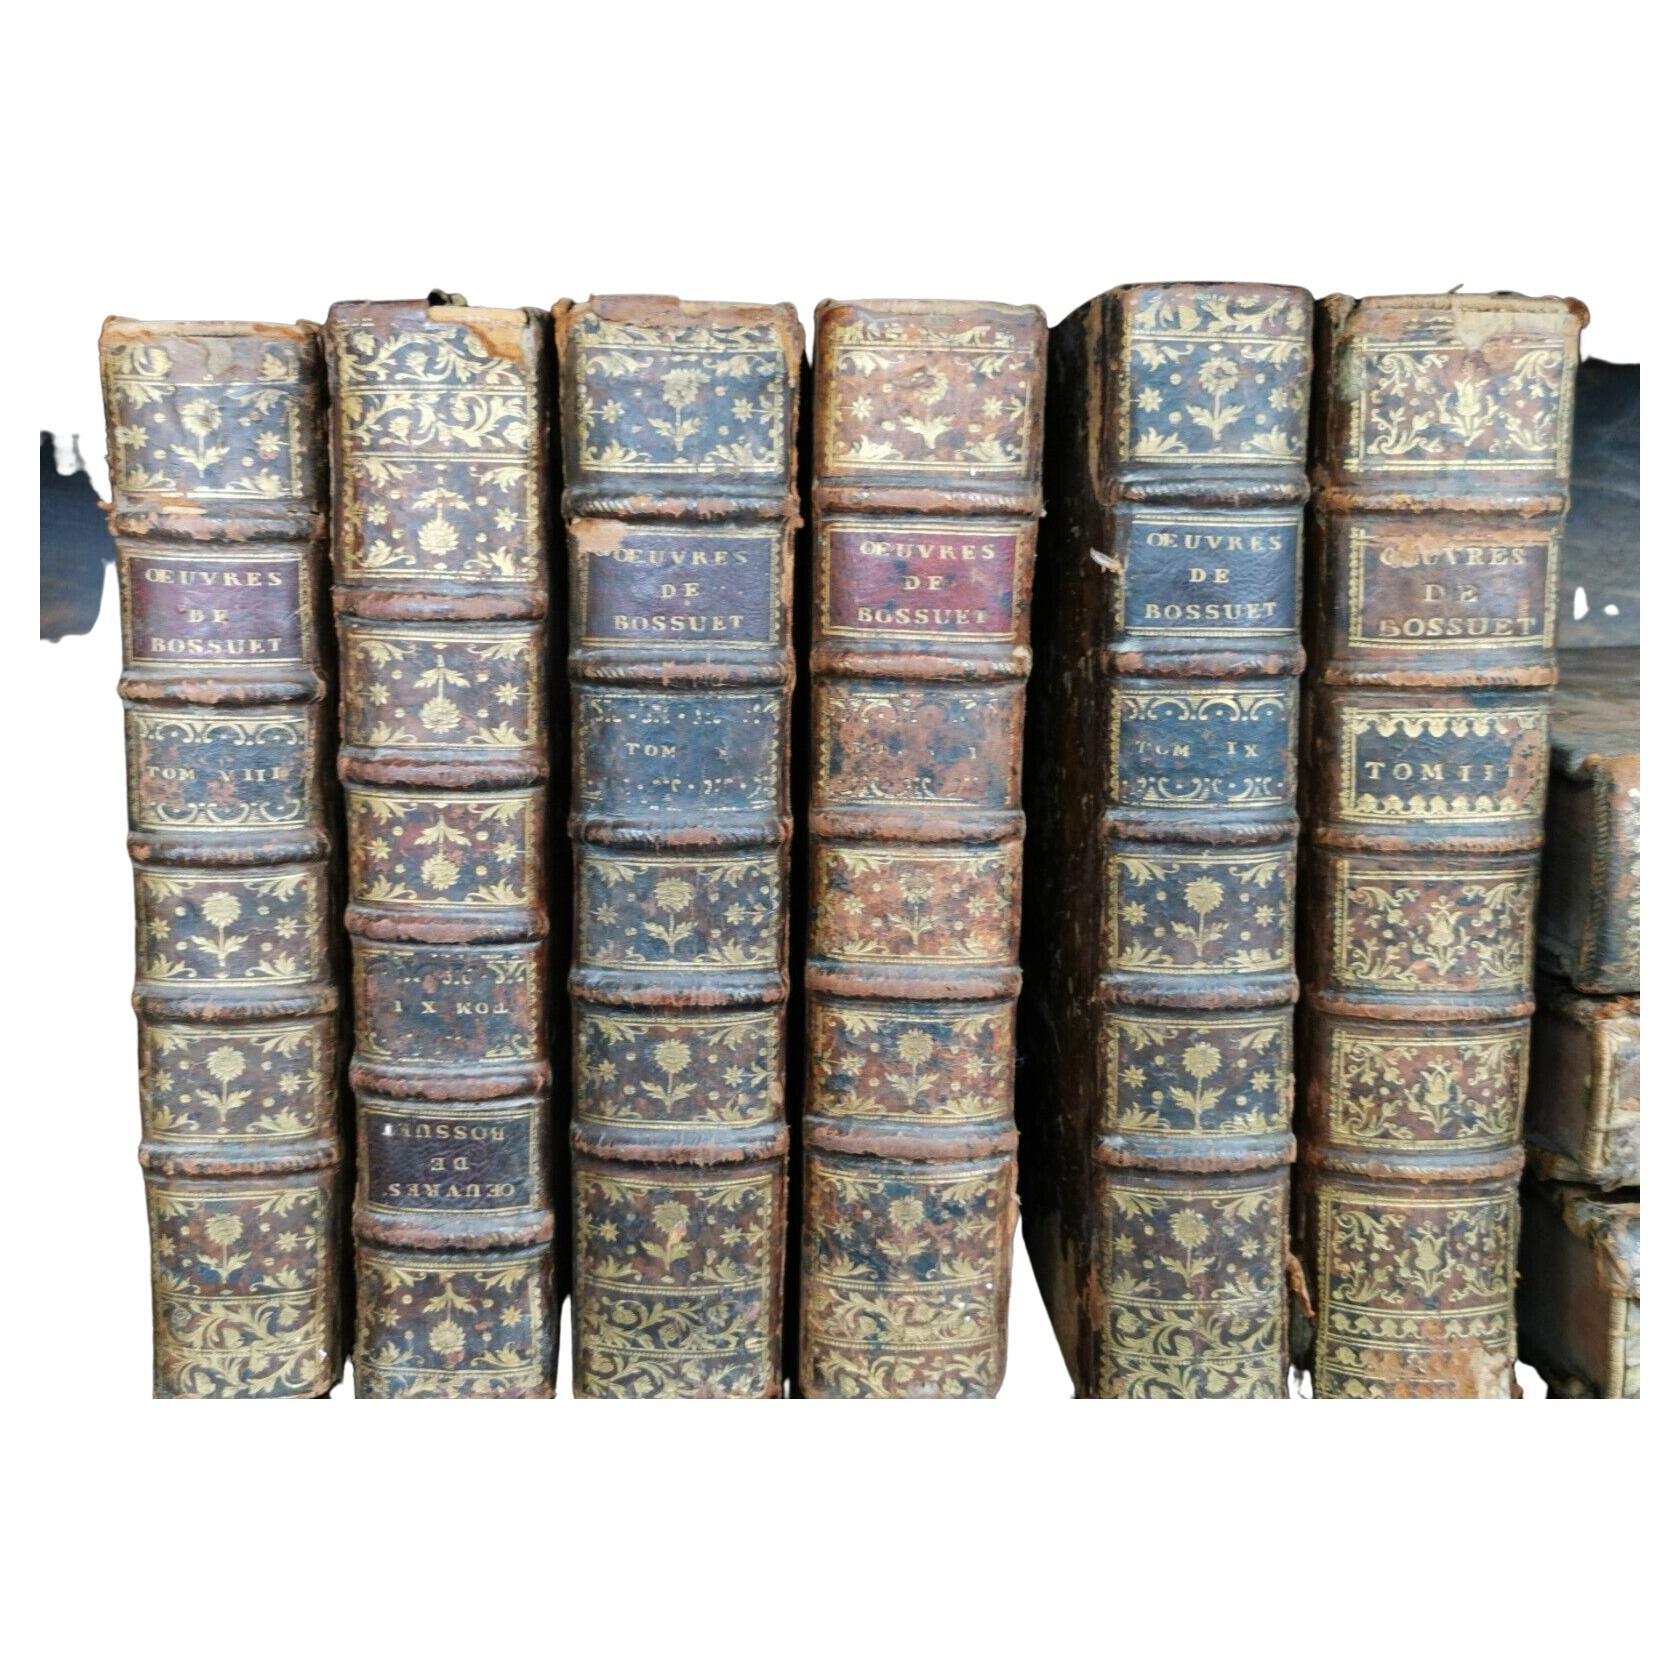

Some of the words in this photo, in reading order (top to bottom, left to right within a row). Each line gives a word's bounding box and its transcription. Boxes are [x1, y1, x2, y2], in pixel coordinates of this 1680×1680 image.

[903, 575, 944, 591] DE
[1189, 567, 1231, 584] DE
[661, 582, 700, 599] DE
[188, 608, 230, 624] DE
[858, 607, 988, 625] BOSSUET
[1144, 602, 1277, 620] BOSSUET
[614, 614, 744, 632] BOSSUET
[1379, 617, 1537, 637] BOSSUET
[151, 637, 283, 655] BOSSUET
[624, 742, 677, 758] TOM
[1227, 741, 1259, 758] IX
[148, 766, 196, 781] TOM
[1364, 762, 1445, 781] TOM
[456, 1001, 510, 1015] TOM
[430, 1157, 470, 1172] DE
